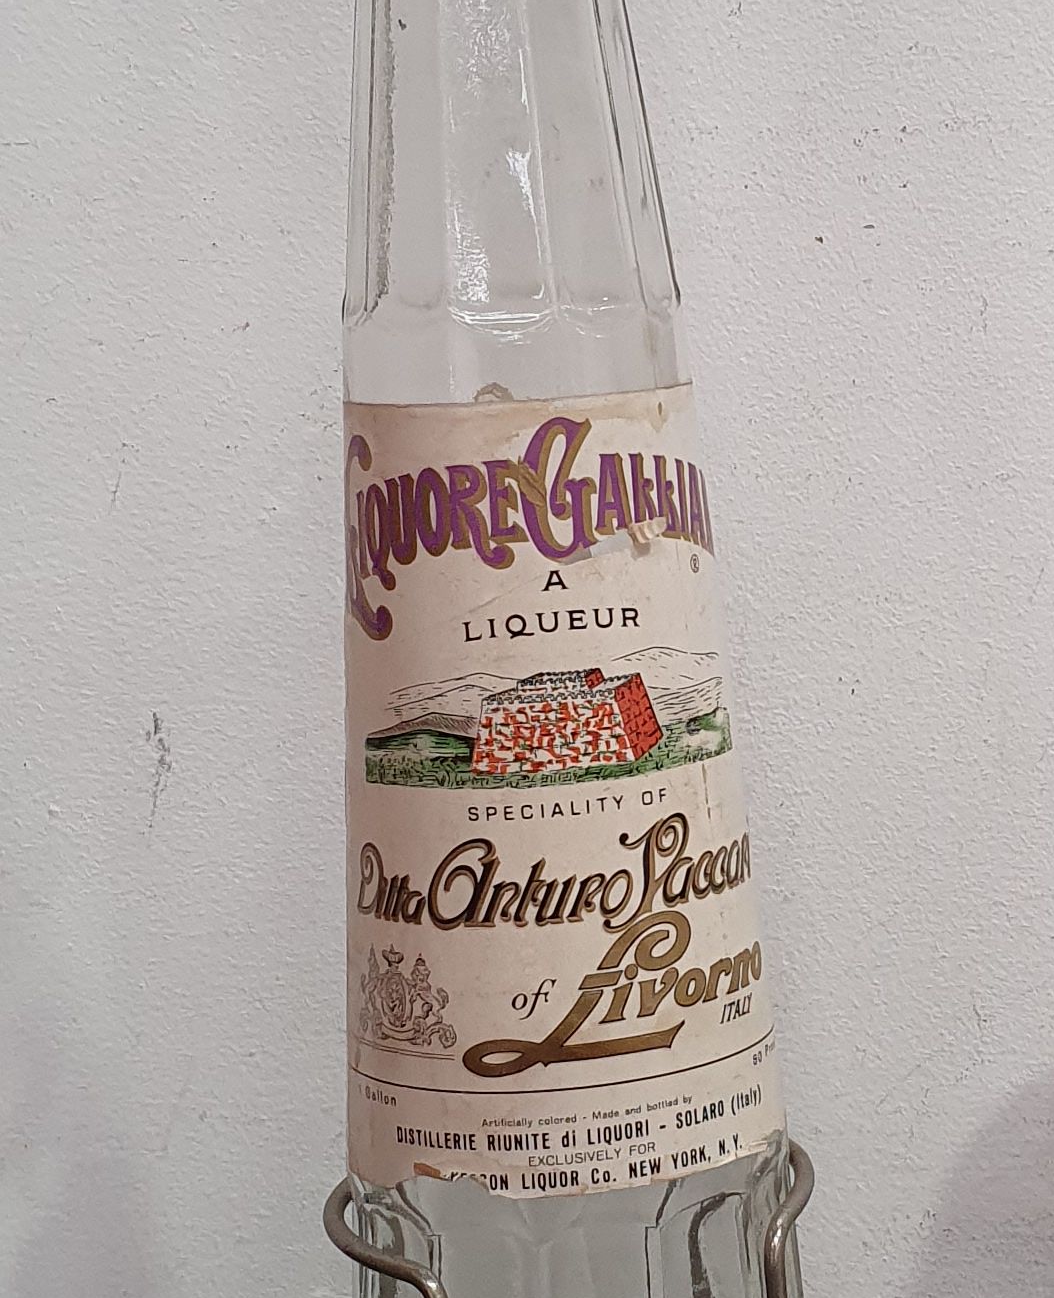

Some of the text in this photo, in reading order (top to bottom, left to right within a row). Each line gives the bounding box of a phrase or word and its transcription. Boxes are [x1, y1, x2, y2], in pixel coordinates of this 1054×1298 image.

[541, 570, 568, 592] A
[462, 607, 641, 643] LIQUEUR
[468, 788, 667, 822] SPECIALITY OF
[428, 837, 633, 930] Arturo
[462, 910, 762, 1078] Livorno
[511, 978, 557, 1021] of
[720, 992, 753, 1024] ITALY
[396, 1125, 477, 1151] DISTILLERIE
[487, 1132, 551, 1152] RIUNITE
[561, 1130, 577, 1148] di
[587, 1119, 649, 1146] LIQUORI
[675, 1100, 724, 1130] SOLARO
[731, 1084, 762, 1116] (Italy)
[481, 1117, 533, 1128] Artificially
[538, 1114, 577, 1126] colored
[592, 1110, 620, 1121] Made
[625, 1105, 642, 1116] and
[682, 1094, 693, 1104] by
[521, 1170, 579, 1191] LIQUOR
[591, 1167, 617, 1185] Co.
[628, 1156, 662, 1179] NEW
[671, 1145, 712, 1170] YORK,
[528, 1142, 656, 1168] EXCLUSIVELY FOR
